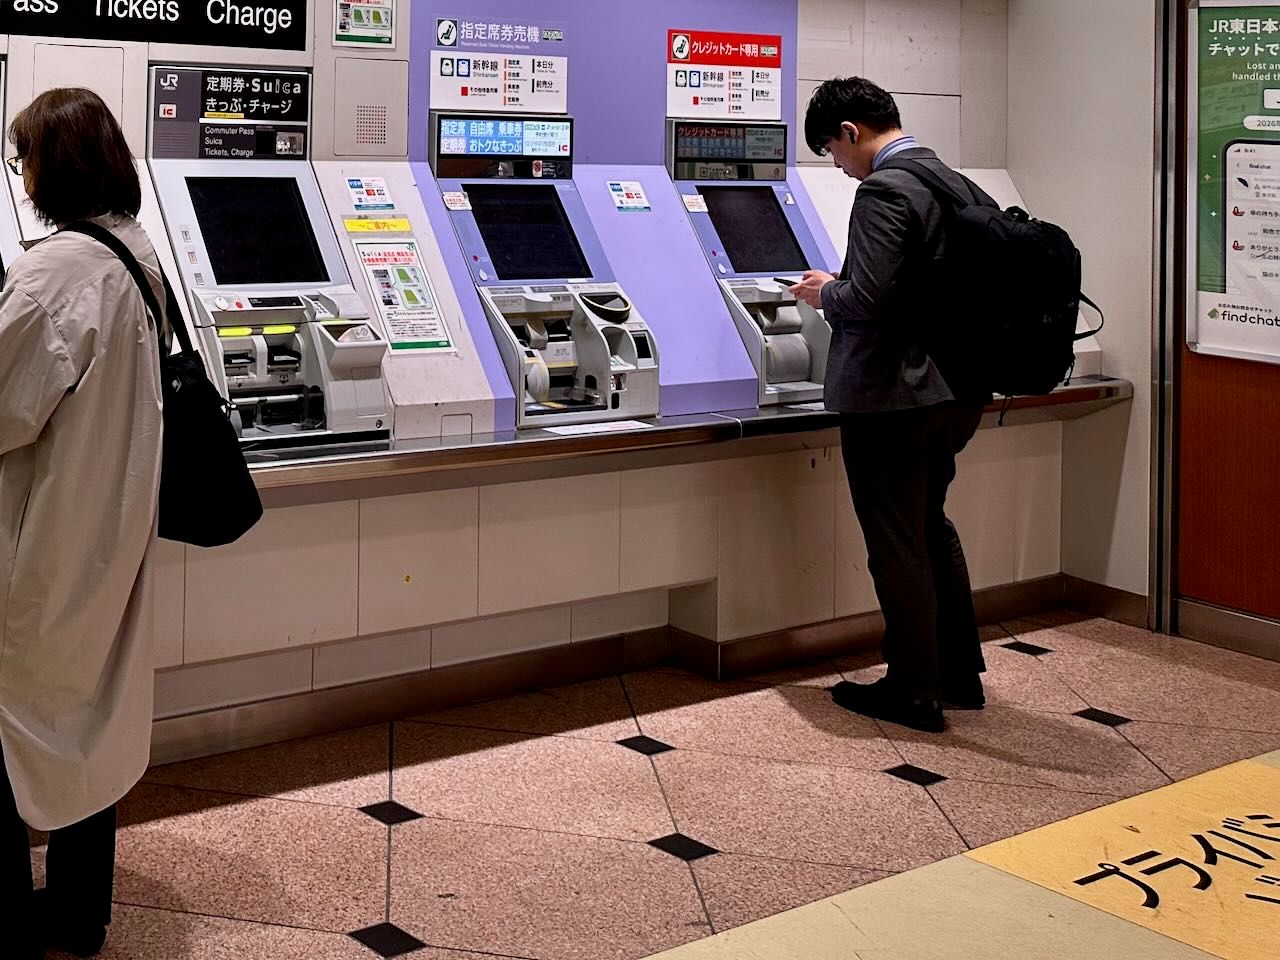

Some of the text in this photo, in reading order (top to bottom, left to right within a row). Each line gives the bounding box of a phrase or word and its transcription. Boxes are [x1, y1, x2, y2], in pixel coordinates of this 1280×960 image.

[1209, 18, 1280, 34] JR東日本
[461, 22, 540, 43] 指定席券売機
[692, 41, 758, 57] クレジットカード専用
[473, 60, 498, 71] 新幹線
[1247, 62, 1266, 70] Lost
[160, 74, 178, 88] JR
[1232, 72, 1270, 80] handled
[205, 98, 292, 114] きっぷ・チャージ
[204, 126, 254, 135] Commuter Pass
[204, 137, 223, 145] Suica
[204, 148, 254, 158] Tickets, Charge
